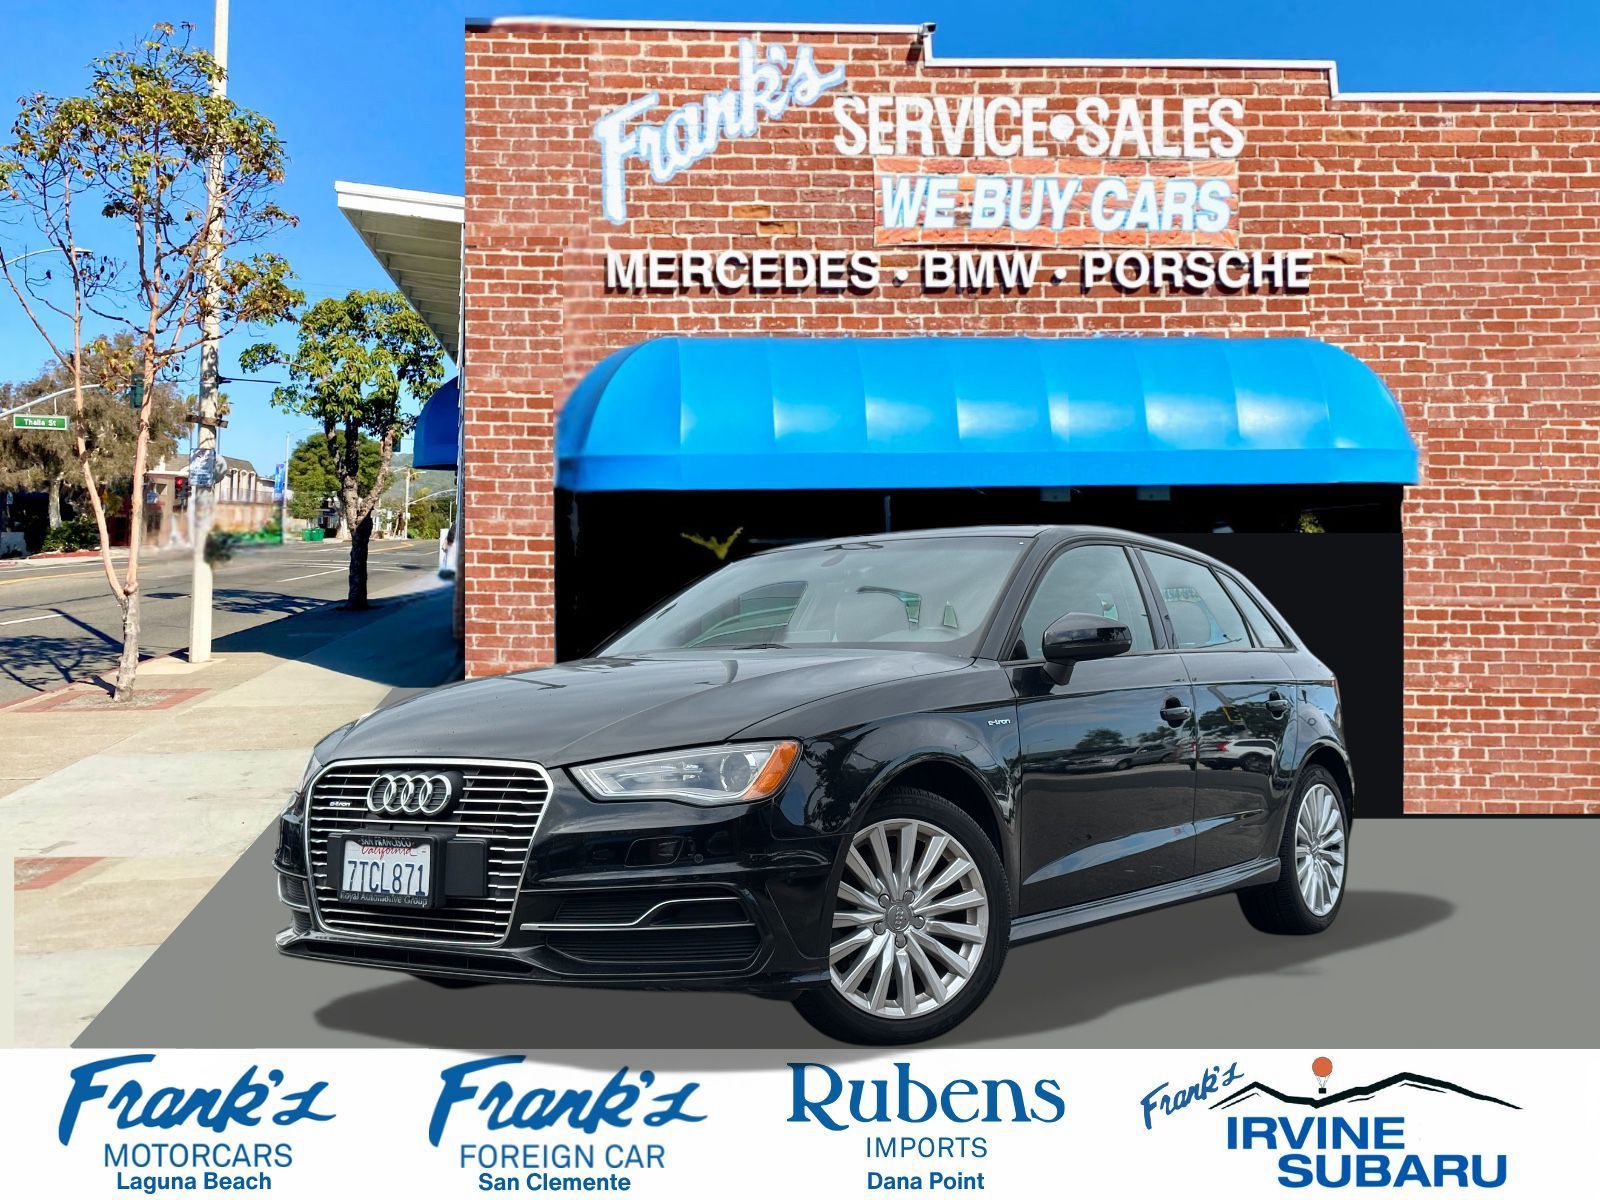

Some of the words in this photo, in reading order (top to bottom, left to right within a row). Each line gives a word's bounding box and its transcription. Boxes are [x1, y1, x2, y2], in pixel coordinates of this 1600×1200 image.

[593, 38, 846, 225] Frank's
[833, 96, 1048, 157] SERVICE
[1075, 98, 1246, 159] SALES
[880, 175, 966, 231] WE
[974, 177, 1080, 232] BUY
[1090, 179, 1232, 232] CARS
[605, 250, 881, 290] MERCEDES
[922, 252, 1040, 291] BMW
[1081, 250, 1314, 291] PORSCHE
[48, 419, 57, 427] St
[987, 718, 1011, 726] e-tron
[347, 860, 426, 897] 7TCL871
[404, 896, 428, 907] Group
